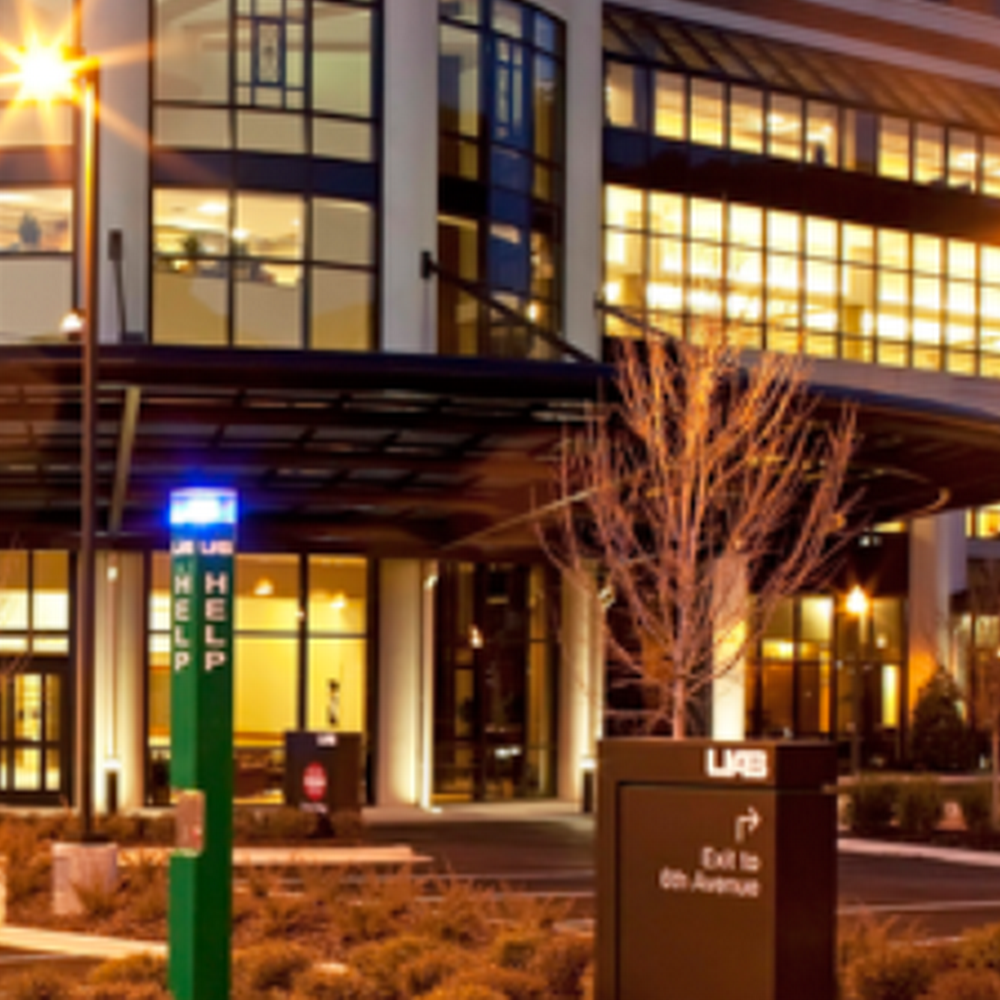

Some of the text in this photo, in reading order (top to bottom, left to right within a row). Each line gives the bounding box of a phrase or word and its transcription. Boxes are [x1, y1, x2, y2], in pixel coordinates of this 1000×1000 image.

[174, 573, 193, 672] HELP
[204, 570, 229, 672] HELP
[706, 747, 769, 779] UAB
[701, 846, 761, 873] Exit to
[691, 867, 760, 898] Avenue
